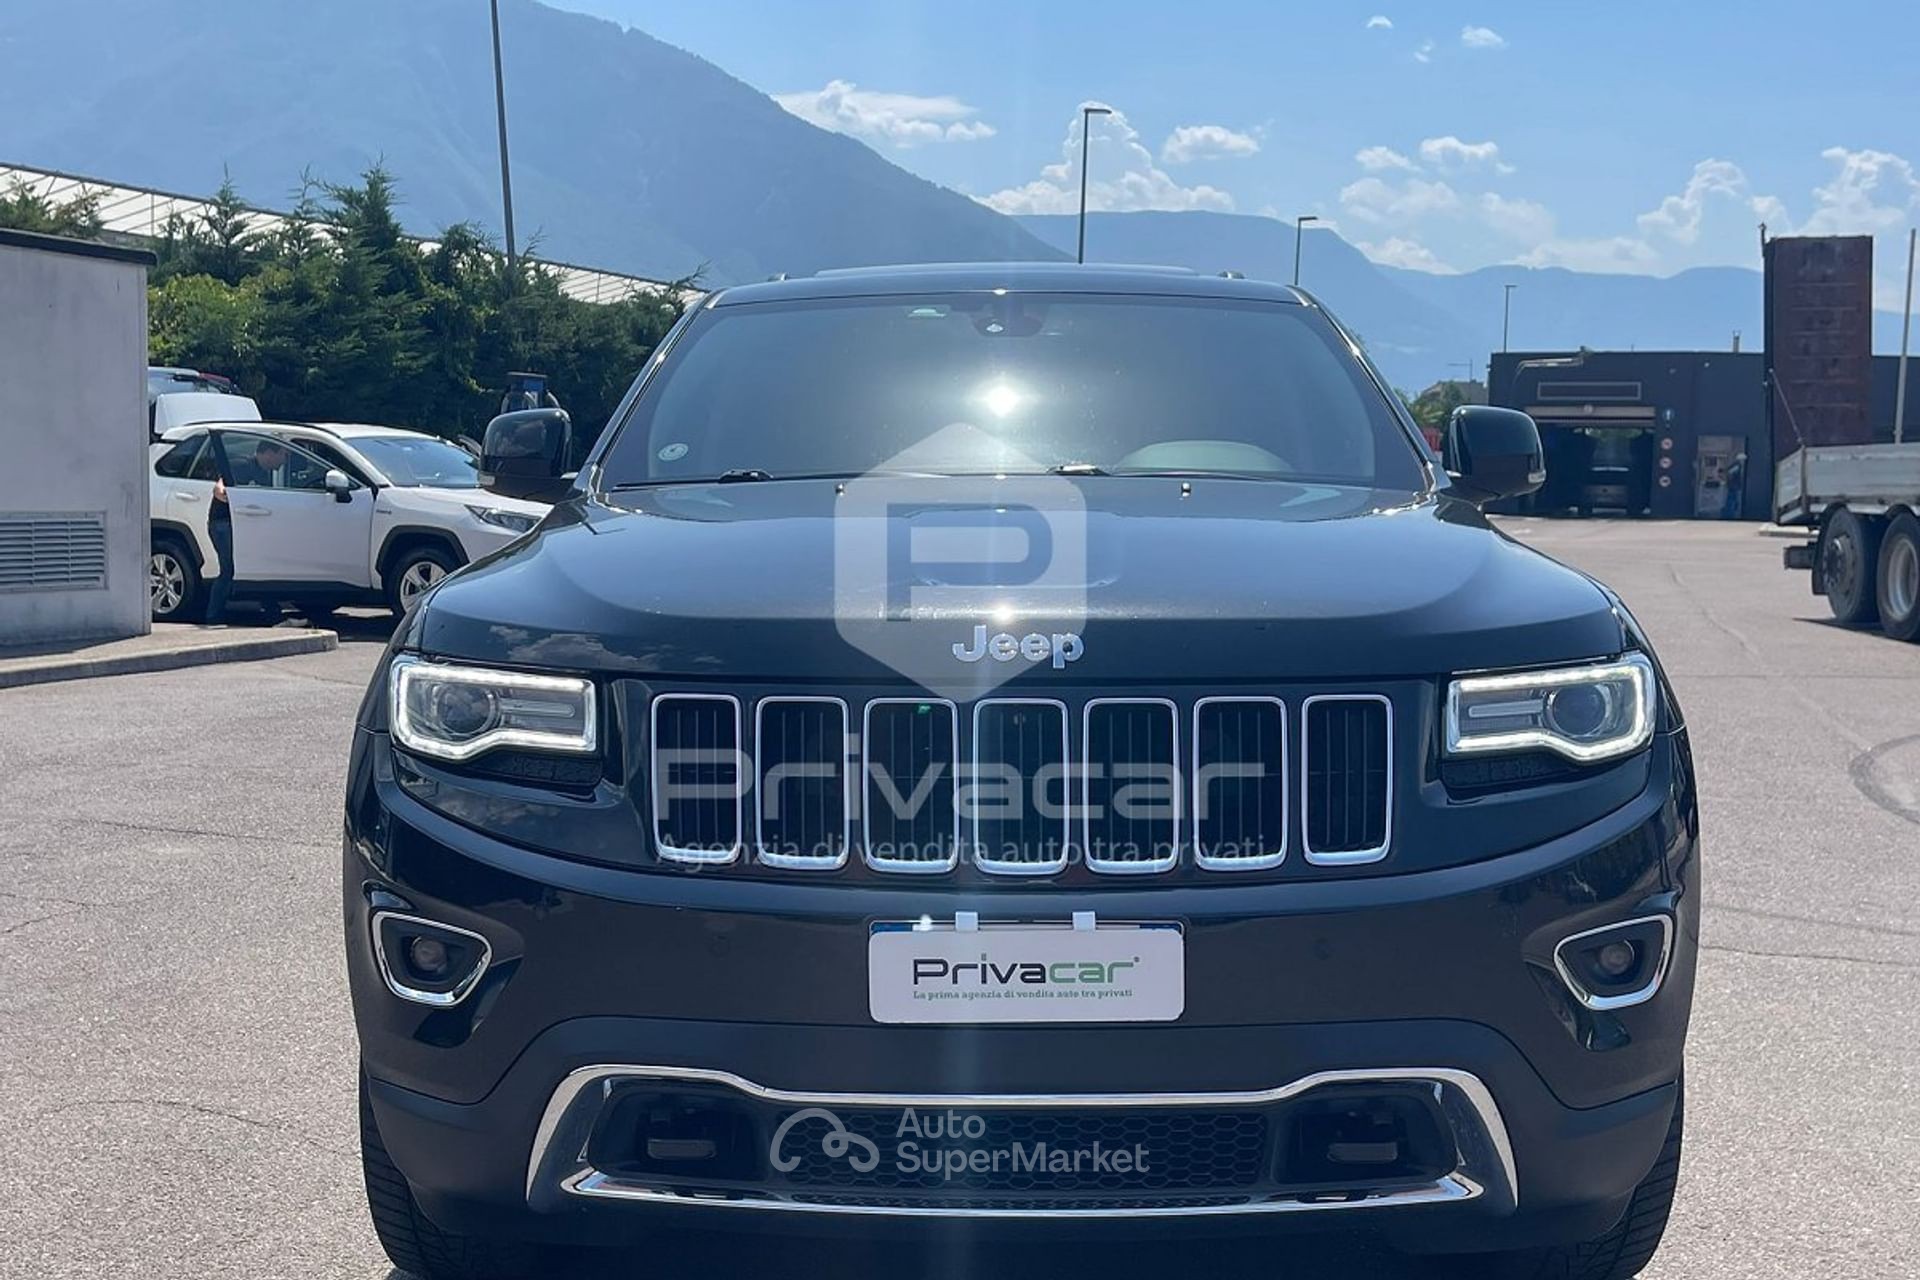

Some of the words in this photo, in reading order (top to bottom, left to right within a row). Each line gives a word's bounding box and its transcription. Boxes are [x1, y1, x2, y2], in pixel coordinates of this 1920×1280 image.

[952, 624, 1085, 669] Jeep
[912, 953, 1133, 985] Privacar
[913, 990, 926, 999] La
[928, 990, 960, 1001] prima
[961, 990, 1002, 1001] agenzia
[1003, 989, 1015, 999] di
[1016, 988, 1055, 999] vendita
[1057, 989, 1080, 999] auto
[1081, 989, 1096, 999] tra
[1098, 988, 1133, 1000] privati
